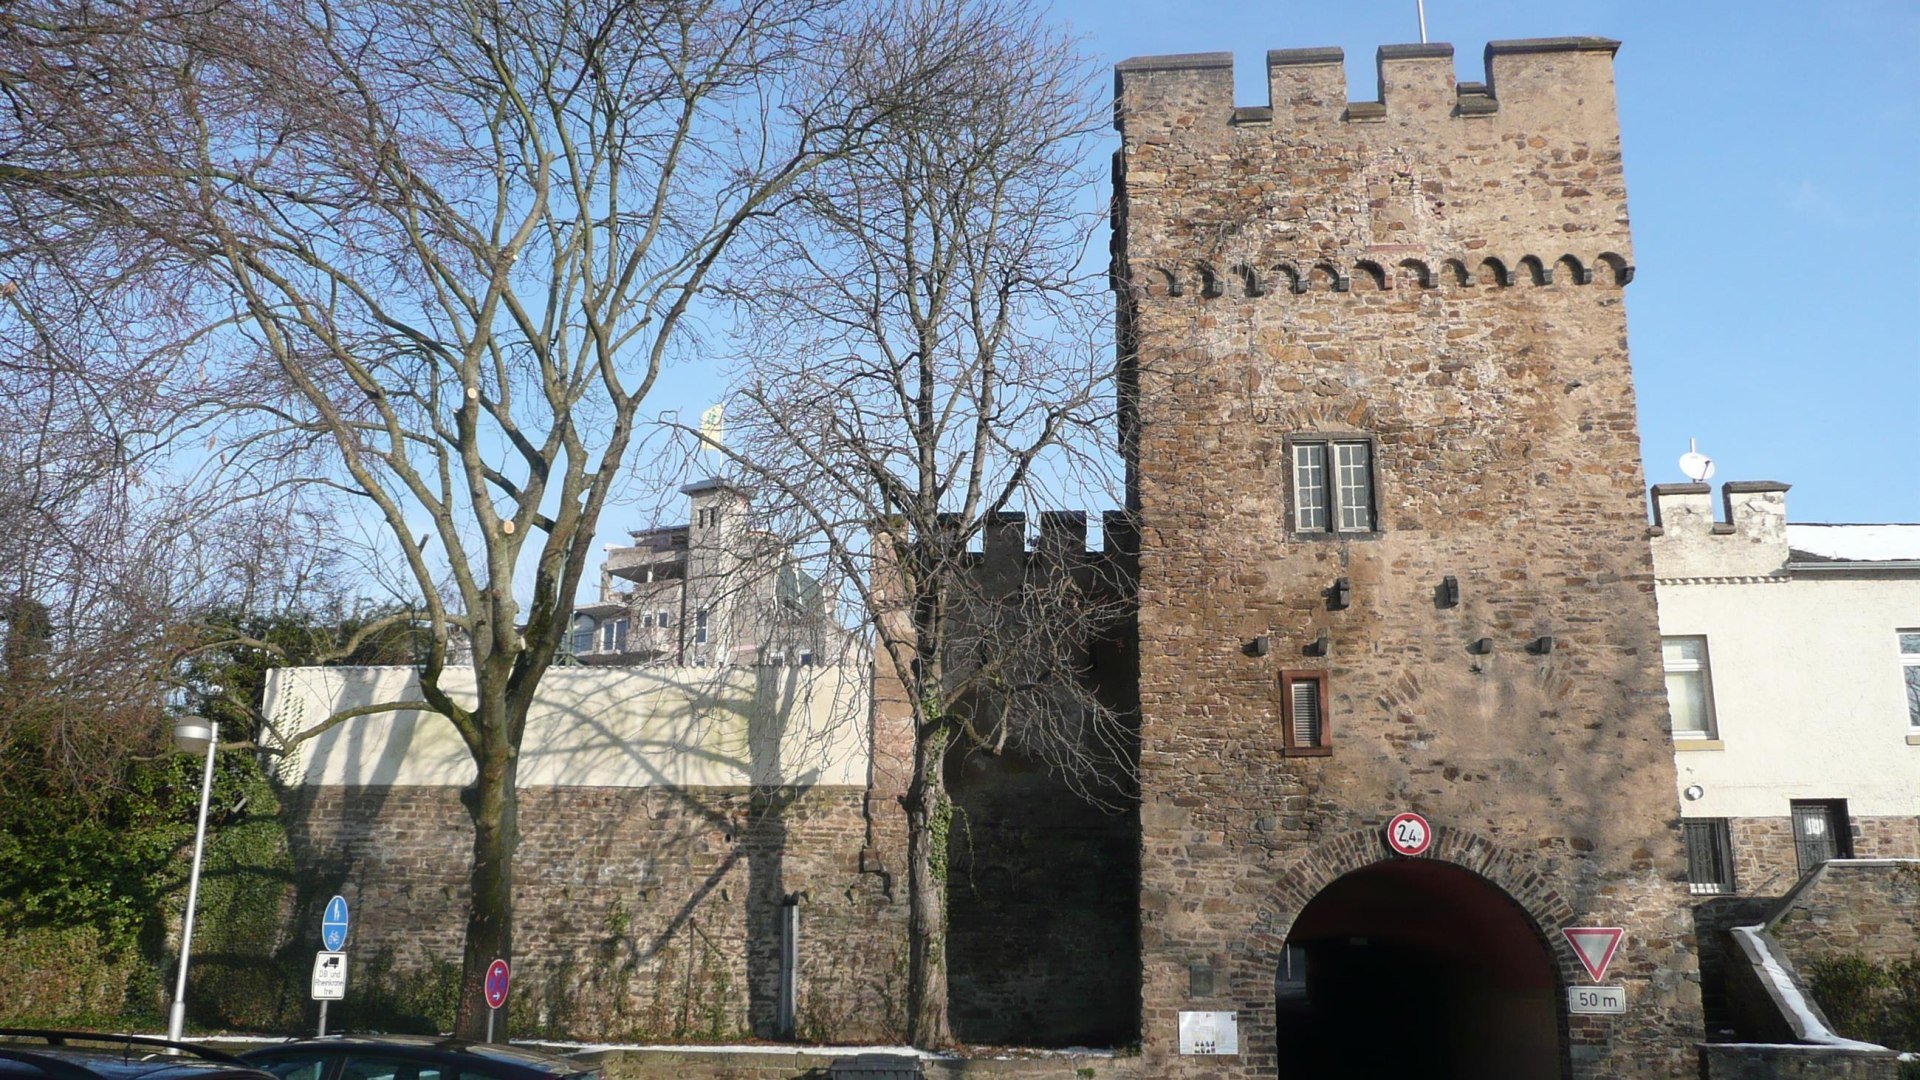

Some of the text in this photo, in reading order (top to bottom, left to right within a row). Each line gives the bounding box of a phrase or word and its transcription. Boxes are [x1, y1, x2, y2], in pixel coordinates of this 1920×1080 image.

[319, 970, 328, 978] DB
[1579, 992, 1617, 1007] 50 m
